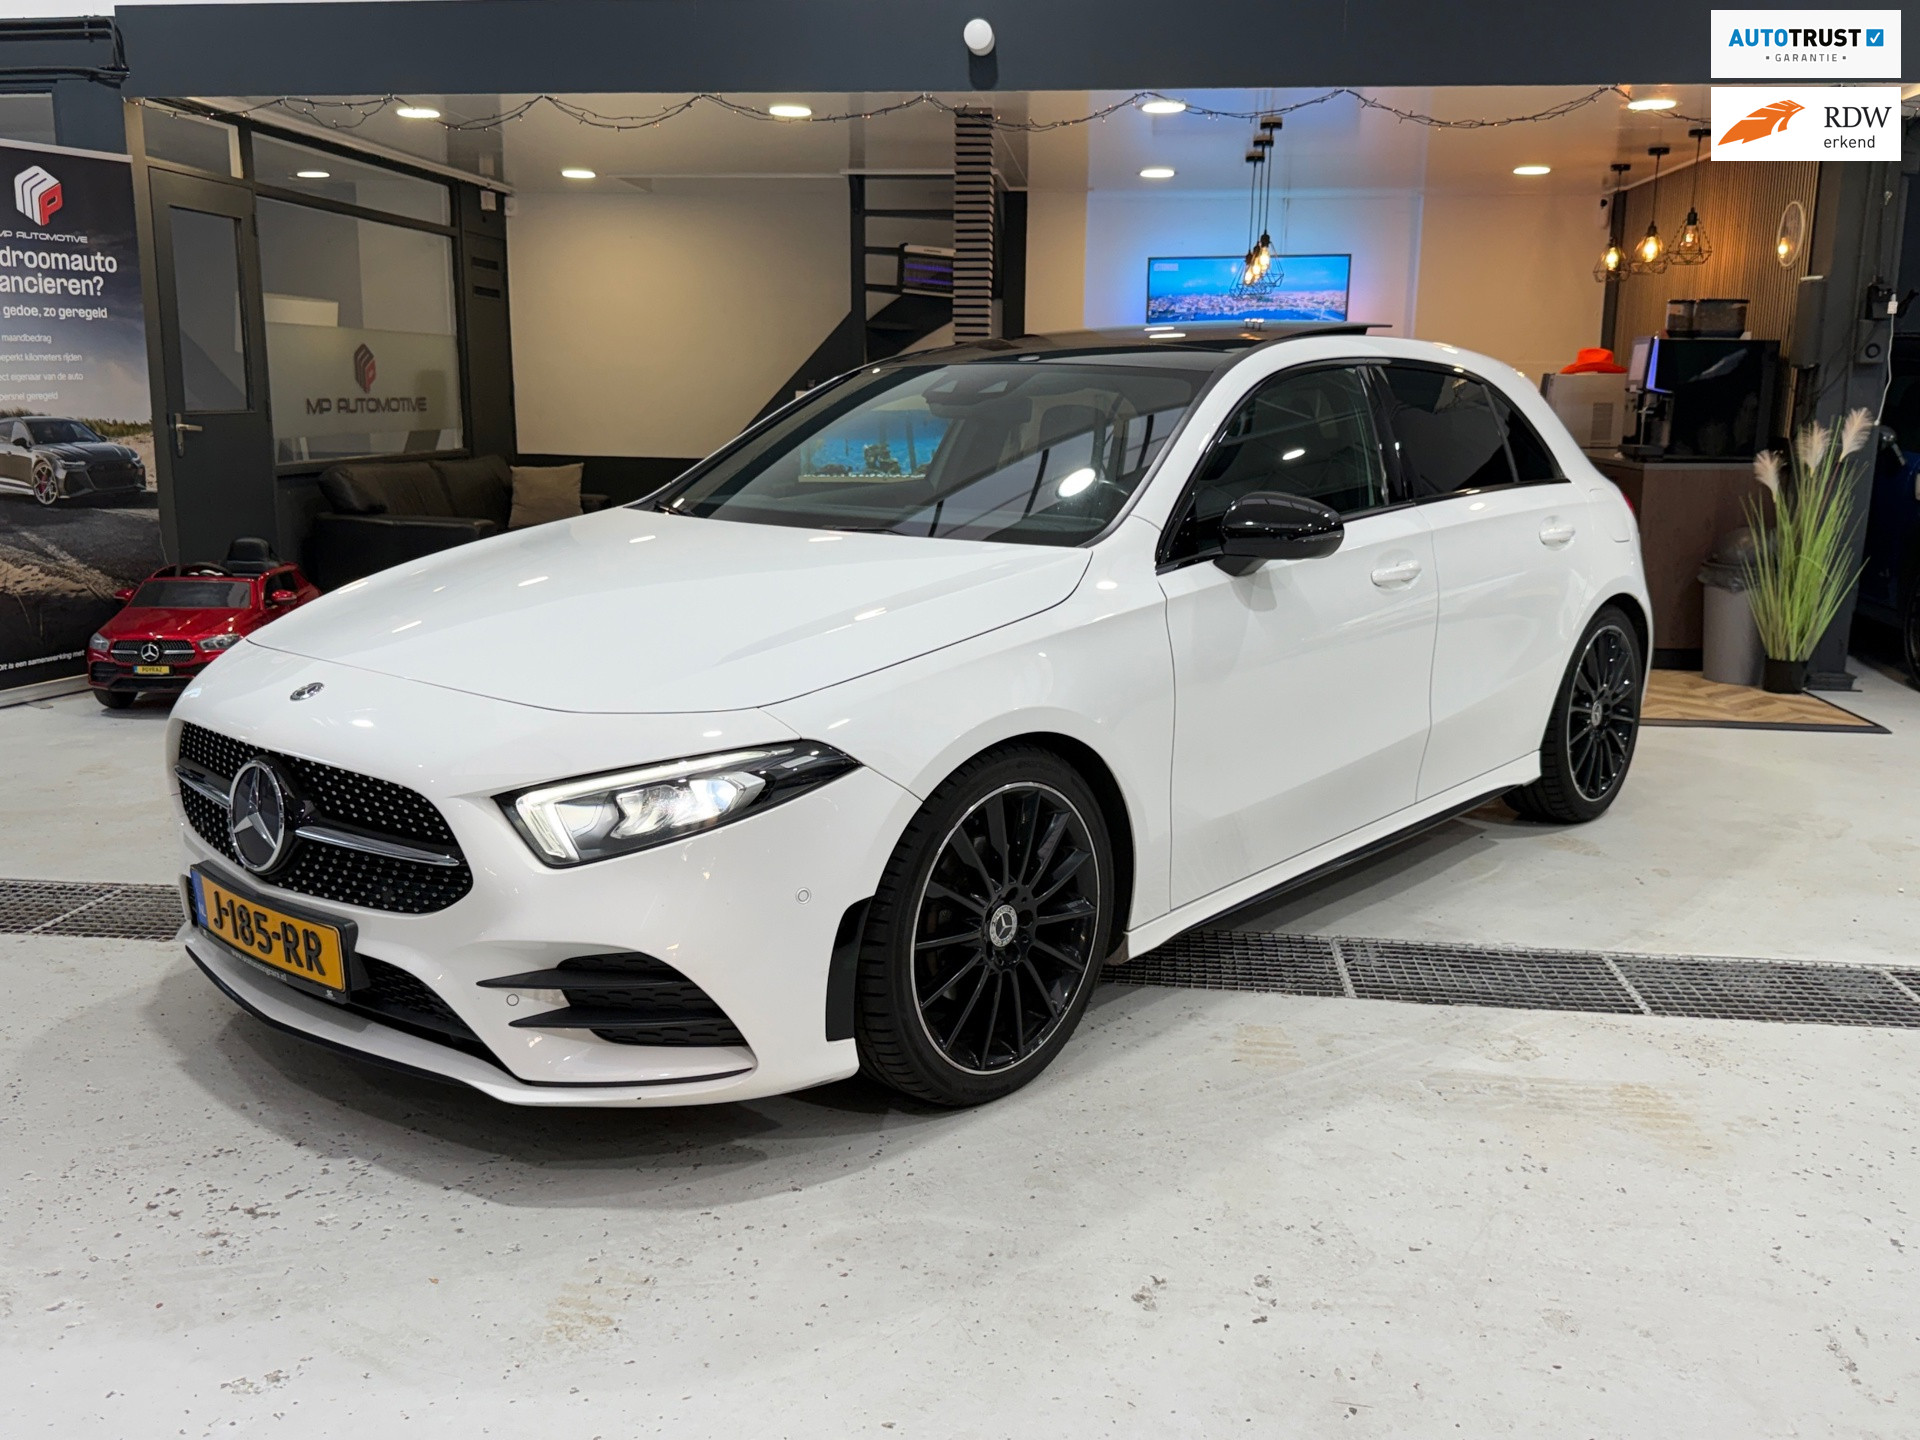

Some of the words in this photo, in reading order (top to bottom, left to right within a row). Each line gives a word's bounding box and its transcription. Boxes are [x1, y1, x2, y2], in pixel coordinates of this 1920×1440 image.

[16, 231, 88, 244] AUTOMOTIVE
[0, 245, 118, 273] droomauto
[0, 272, 104, 296] ancieren?
[3, 304, 42, 319] gedoe,
[43, 307, 57, 317] zo
[58, 306, 108, 321] geregeld
[1, 333, 52, 344] maandbedrag
[306, 398, 332, 415] MP
[337, 397, 427, 413] AUTOMOTIVE
[213, 890, 326, 976] J-185-RR
